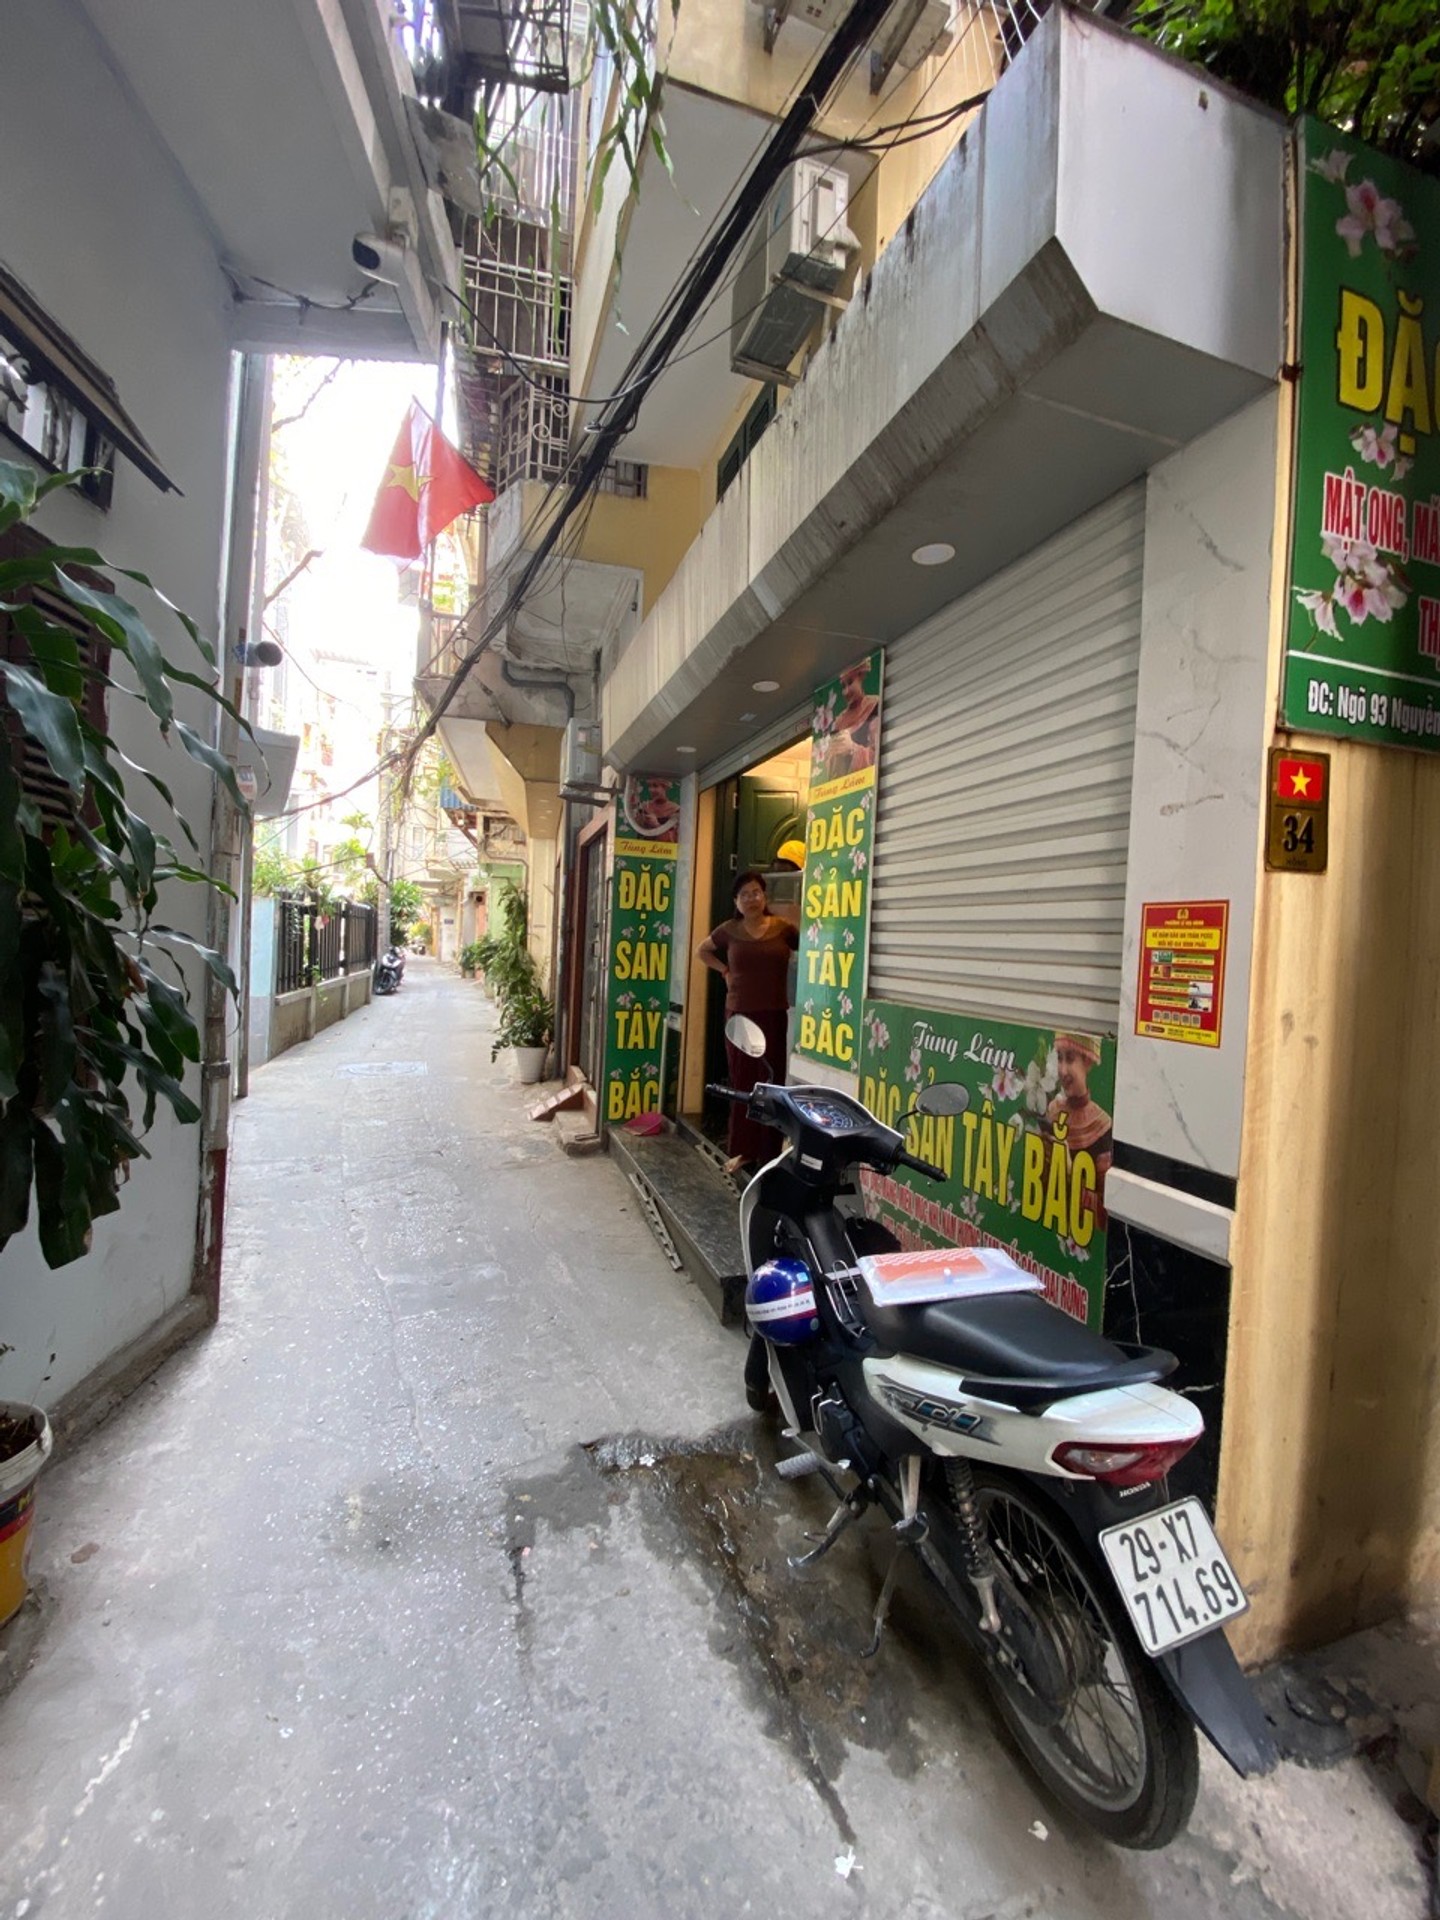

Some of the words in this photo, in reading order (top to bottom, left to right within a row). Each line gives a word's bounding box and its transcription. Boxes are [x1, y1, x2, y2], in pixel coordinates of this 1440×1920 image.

[1336, 287, 1440, 456] ĐẶ
[1323, 466, 1366, 550] MẬT
[1368, 487, 1409, 565] ONG,
[1308, 679, 1334, 716] ĐC:
[1337, 685, 1366, 725] Ngõ
[1370, 693, 1387, 727] 93
[810, 804, 864, 858] ĐẶC
[1282, 813, 1315, 854] 34
[619, 864, 670, 920] ĐẶC
[806, 867, 863, 919] SẢN
[615, 925, 667, 982] SẢN
[806, 944, 855, 989] TÂY
[615, 1003, 661, 1050] TÂY
[801, 1008, 853, 1062] BẮC
[912, 1020, 959, 1062] Tùng
[963, 1032, 1016, 1071] Lâm
[608, 1067, 659, 1120] BẮC
[963, 1098, 1016, 1207] TÂY
[1021, 1111, 1097, 1248] BẮC
[1119, 1480, 1152, 1498] HONDA
[1119, 1509, 1199, 1583] 29-X7
[1133, 1560, 1239, 1645] 714.69
